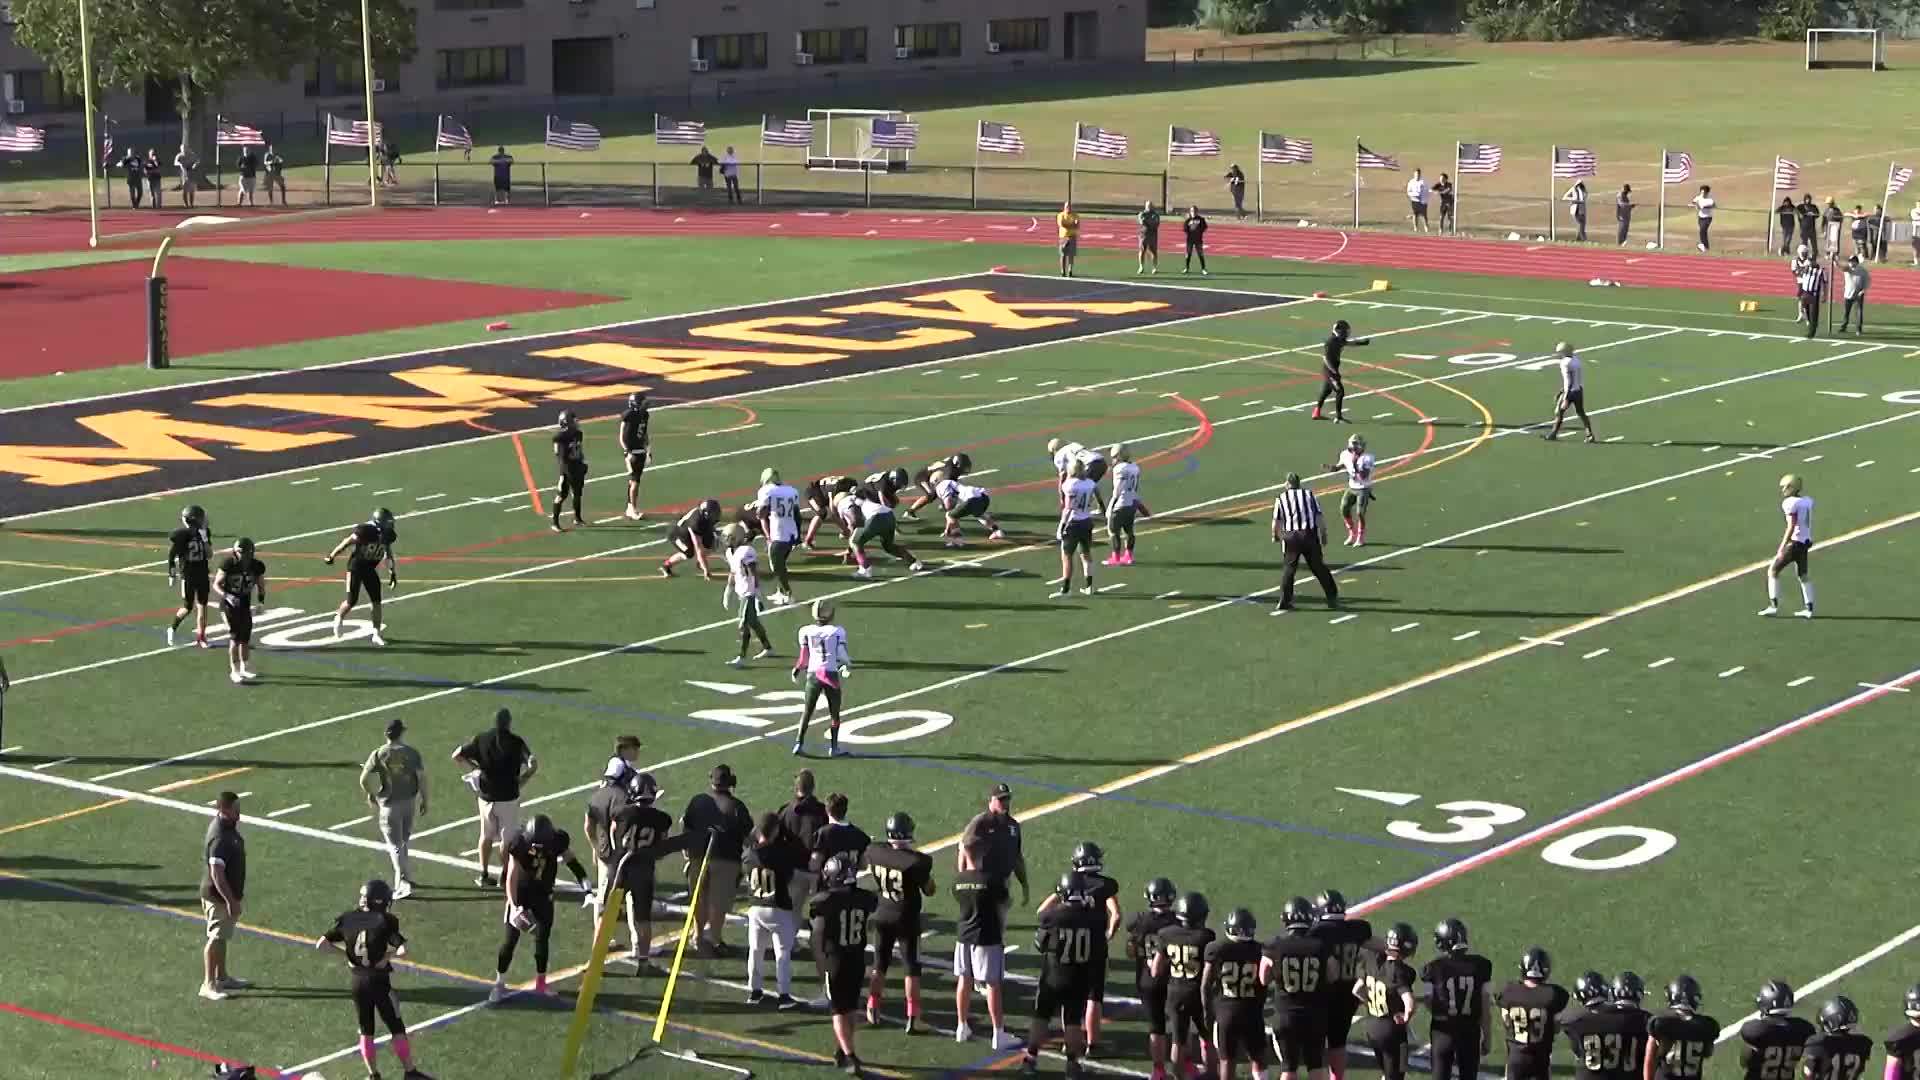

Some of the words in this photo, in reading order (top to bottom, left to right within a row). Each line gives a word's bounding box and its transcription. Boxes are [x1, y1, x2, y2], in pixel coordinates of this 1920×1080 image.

[777, 495, 797, 518] 52
[873, 864, 905, 903] 73
[354, 929, 369, 967] 4
[1058, 927, 1092, 965] 70
[1221, 960, 1258, 998] 22
[1282, 956, 1320, 993] 66
[1364, 975, 1389, 1017] 38
[1446, 976, 1475, 1016] 17
[1509, 1007, 1547, 1044] 23
[1665, 1040, 1704, 1077] 45
[1760, 1045, 1803, 1080] 25
